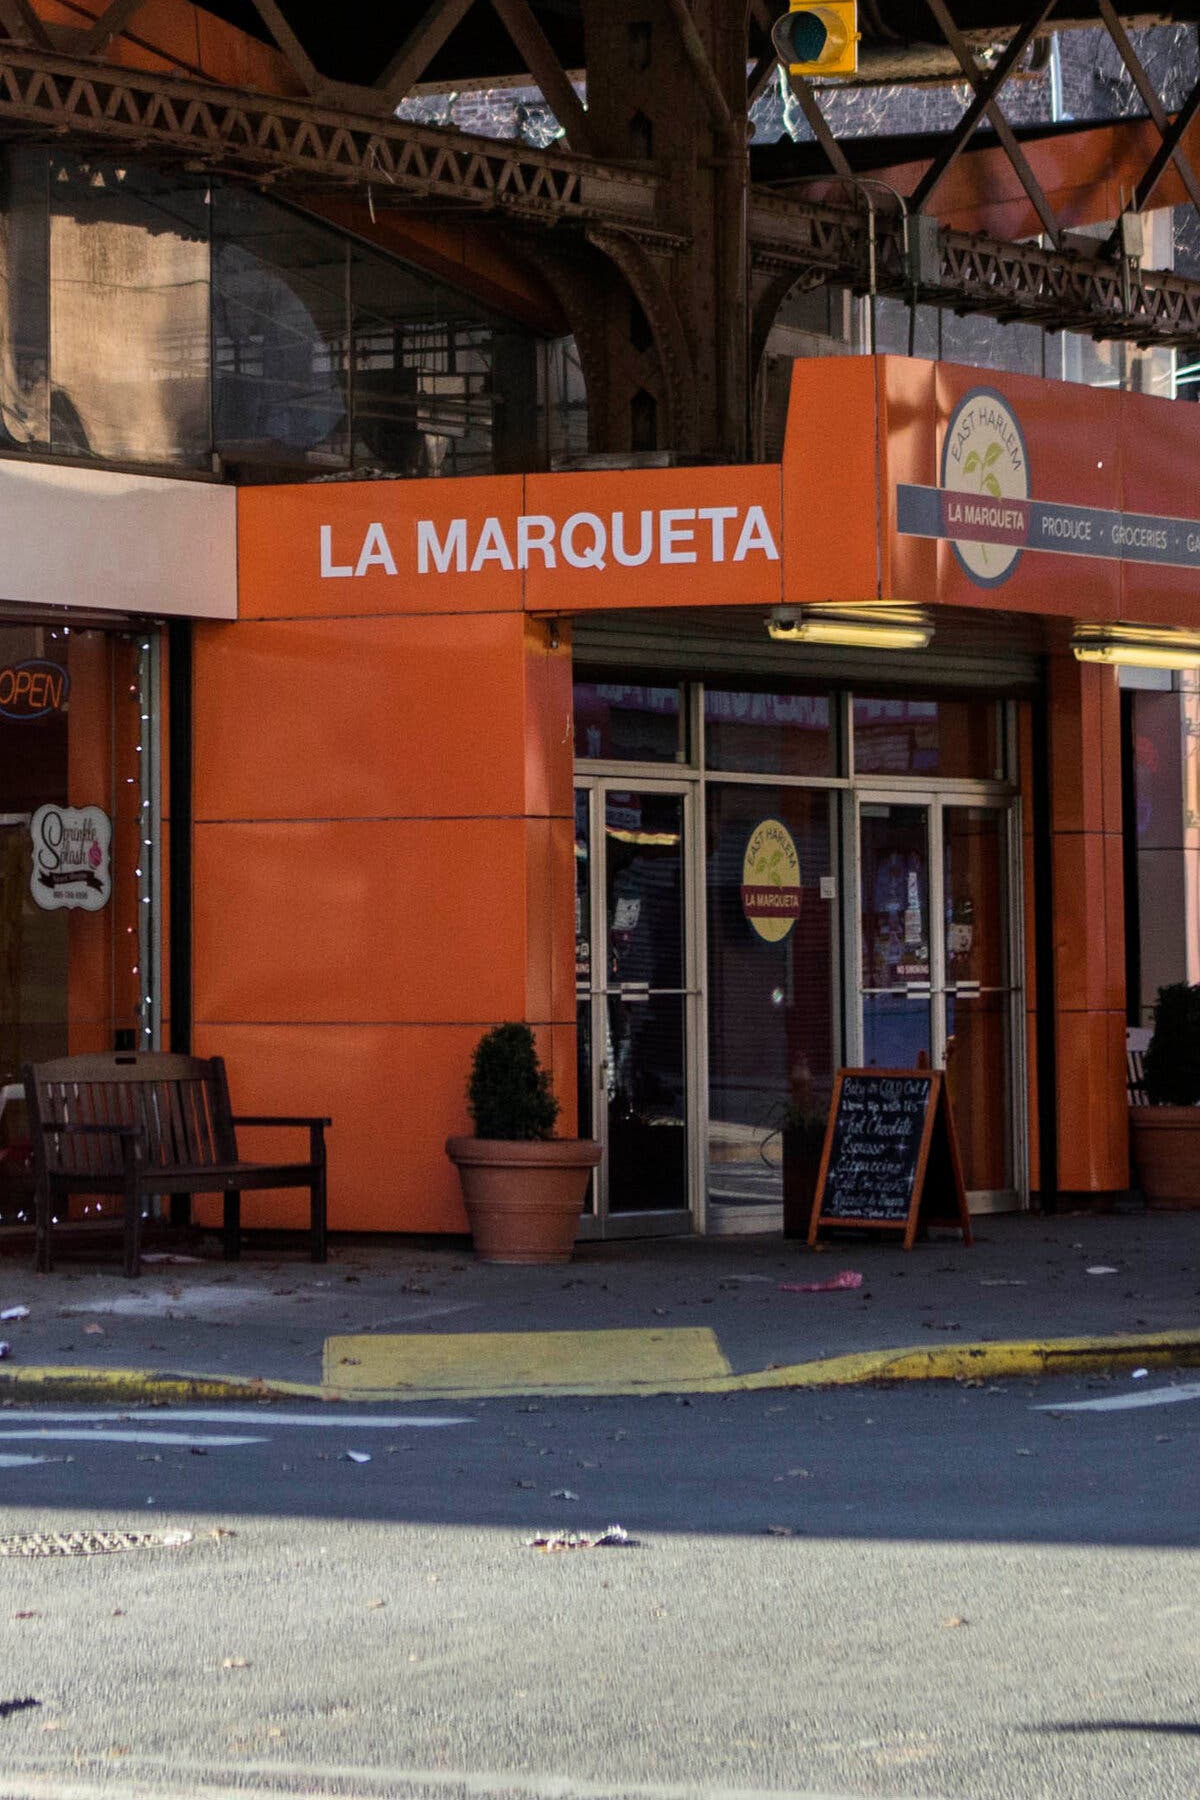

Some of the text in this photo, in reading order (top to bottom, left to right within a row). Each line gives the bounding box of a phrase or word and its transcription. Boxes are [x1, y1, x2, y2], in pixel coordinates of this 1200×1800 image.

[951, 407, 1022, 471] EAST HARLEM
[948, 503, 1025, 530] LA MARQUETA
[1041, 516, 1092, 541] PRODUCE
[1111, 525, 1167, 550] GROCERIES
[320, 506, 780, 578] LA MARQUETA
[747, 828, 797, 868] EAST HARLEM
[745, 893, 799, 907] LA MARQUETA
